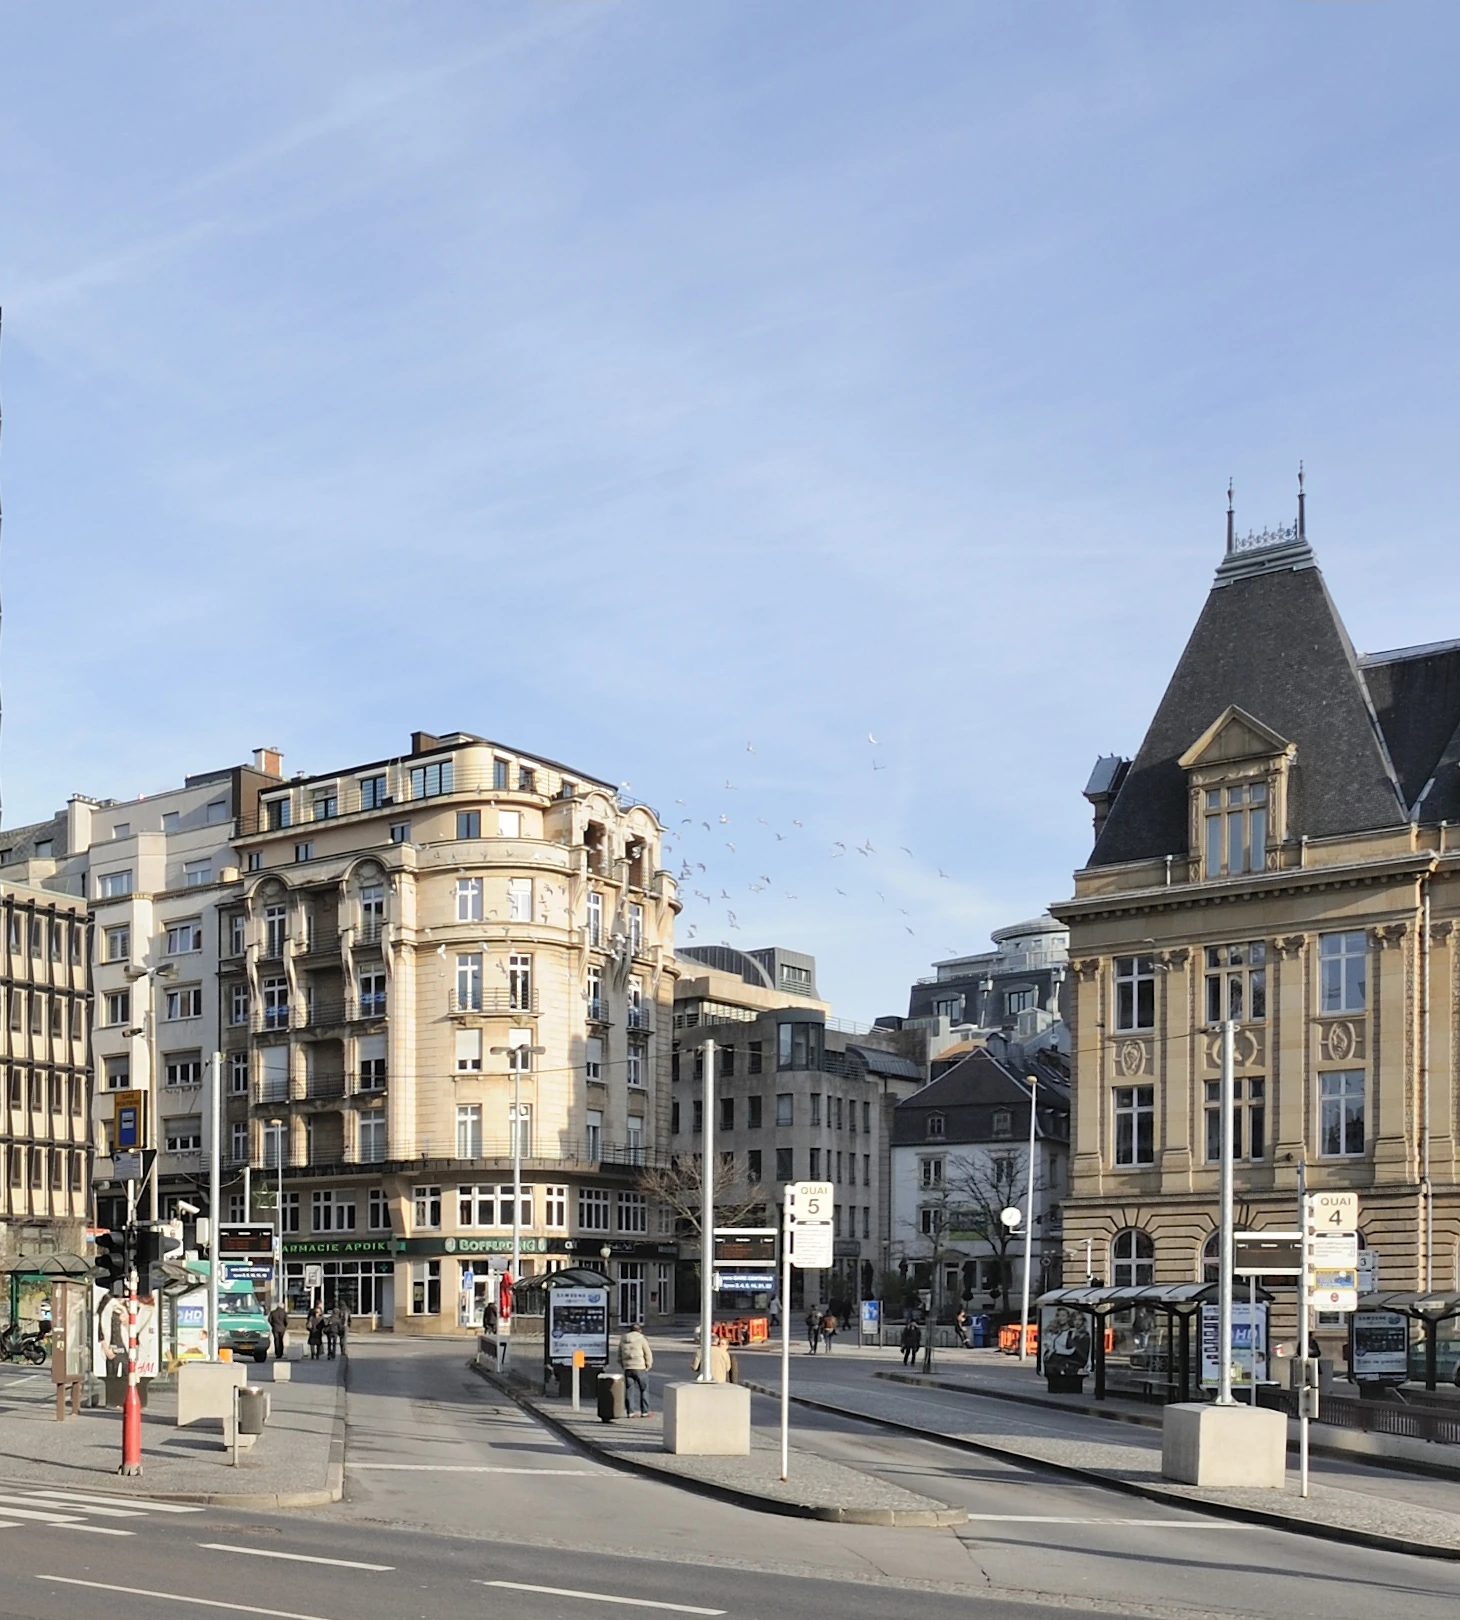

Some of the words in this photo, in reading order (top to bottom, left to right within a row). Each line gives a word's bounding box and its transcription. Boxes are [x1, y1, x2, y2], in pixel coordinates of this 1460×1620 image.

[801, 1186, 828, 1195] QUAI
[807, 1198, 820, 1215] 5
[1320, 1197, 1352, 1206] QUAI
[1328, 1209, 1342, 1226] 4
[282, 1243, 339, 1253] ARMACIE
[344, 1242, 386, 1252] APDIK
[459, 1239, 536, 1252] BOFFERDNG
[1359, 1257, 1367, 1267] 3
